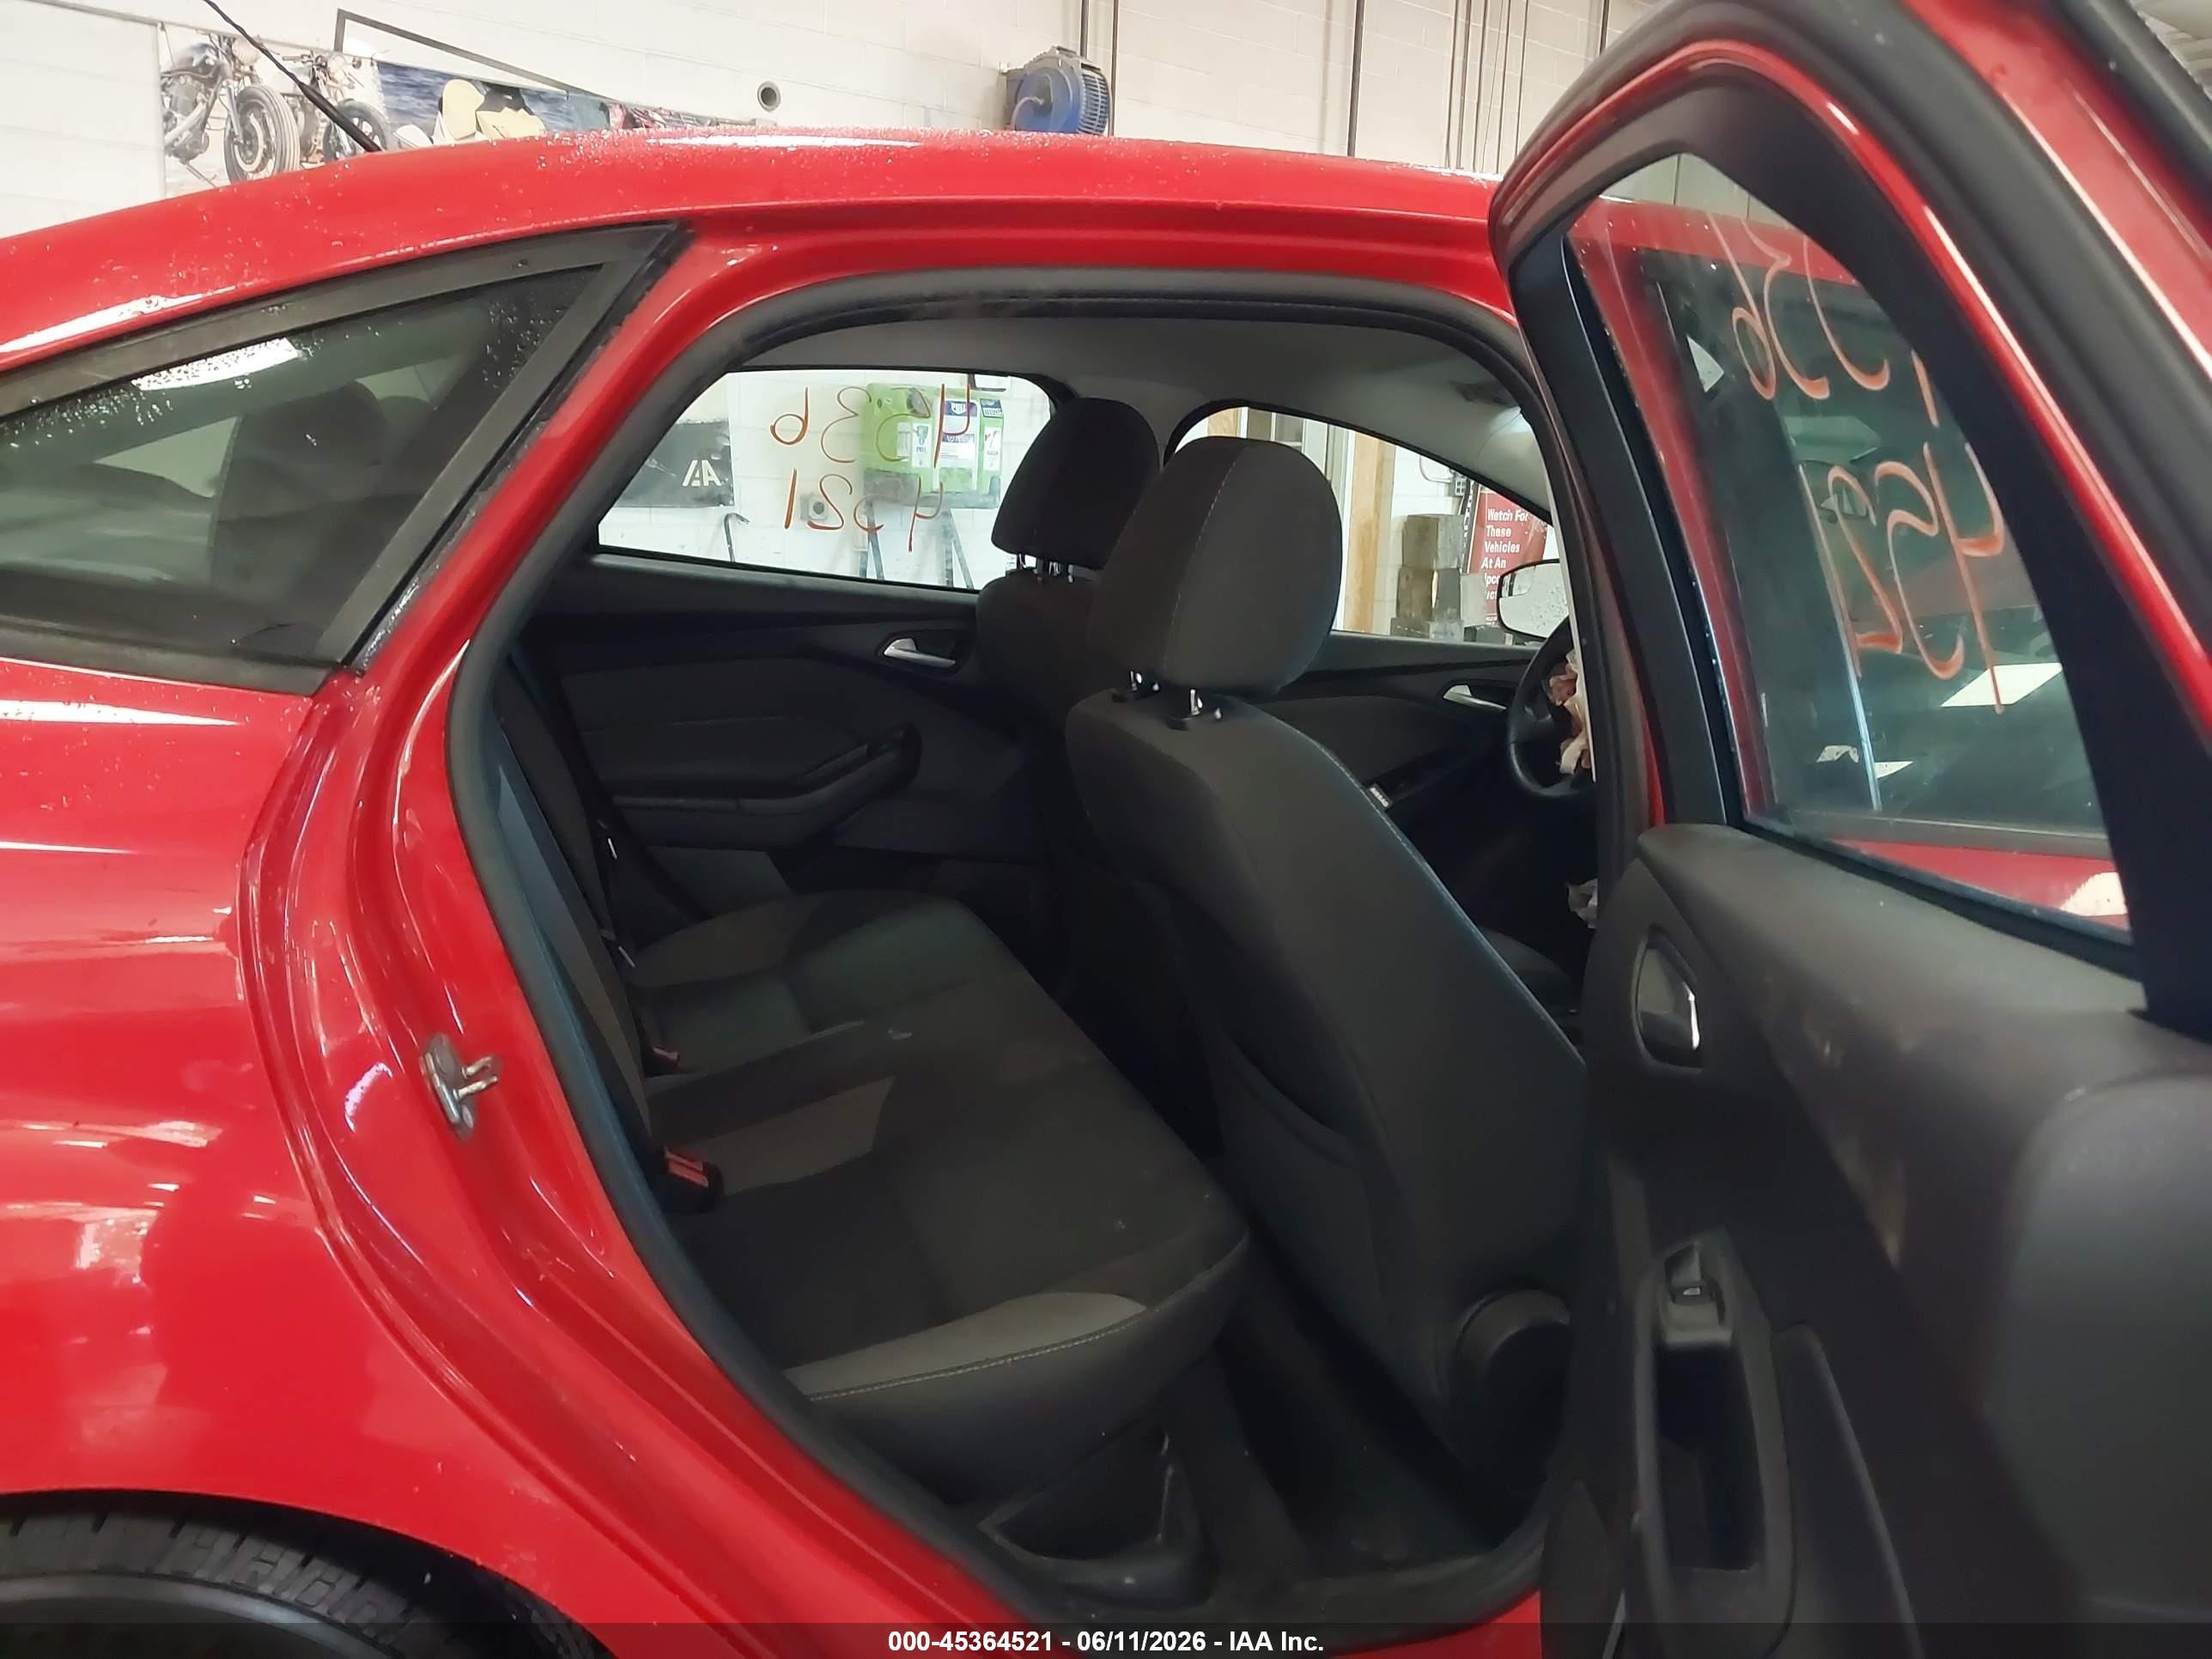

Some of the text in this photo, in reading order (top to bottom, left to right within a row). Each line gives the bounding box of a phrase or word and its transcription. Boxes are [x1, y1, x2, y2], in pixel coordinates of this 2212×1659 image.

[1487, 508, 1529, 522] Watch For
[1486, 525, 1512, 537] These
[1484, 541, 1521, 553] Vehicles
[1480, 556, 1507, 568] At An
